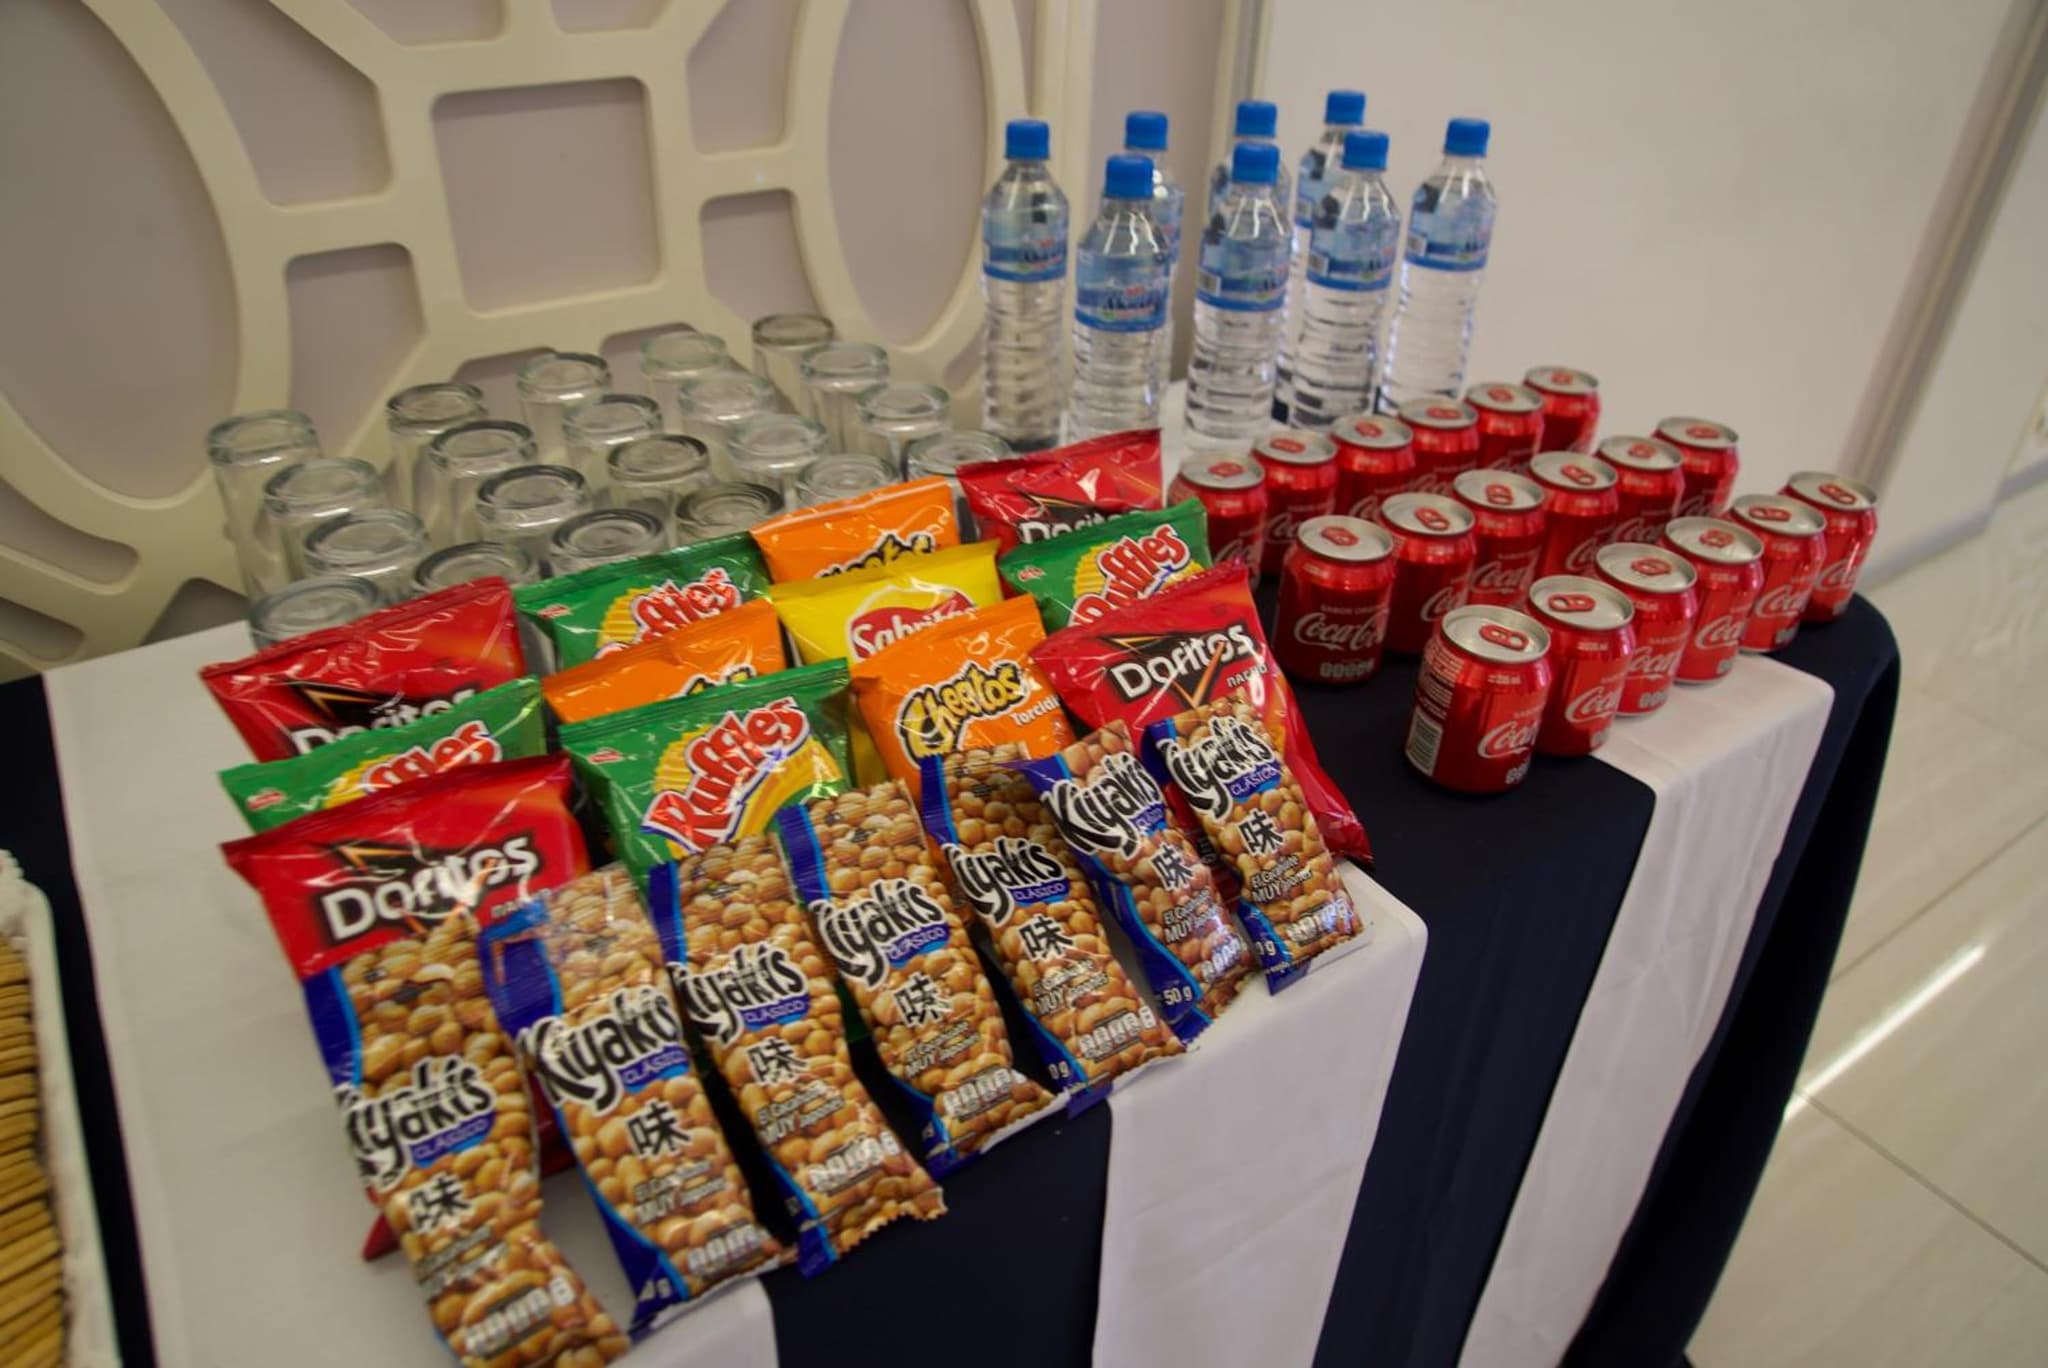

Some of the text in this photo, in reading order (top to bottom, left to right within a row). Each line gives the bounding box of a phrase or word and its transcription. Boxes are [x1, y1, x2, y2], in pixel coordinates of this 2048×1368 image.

[634, 570, 740, 642] ffles
[1111, 625, 1254, 699] Doritos
[899, 662, 1028, 762] Cheetos
[643, 698, 807, 851] Ruffles
[1240, 811, 1283, 854] 味
[321, 836, 539, 941] Doritos
[1013, 882, 1065, 901] CLÁSICO
[1152, 846, 1193, 889] 味
[1252, 880, 1281, 902] MUY
[1019, 916, 1074, 959] 味
[1164, 916, 1193, 943] MUY
[745, 1001, 806, 1024] CLÁSICO
[893, 975, 945, 1025] 味
[1163, 985, 1193, 1006] 50 g
[749, 1037, 807, 1085] 味
[626, 1102, 690, 1155] 味
[408, 1176, 471, 1230] 味
